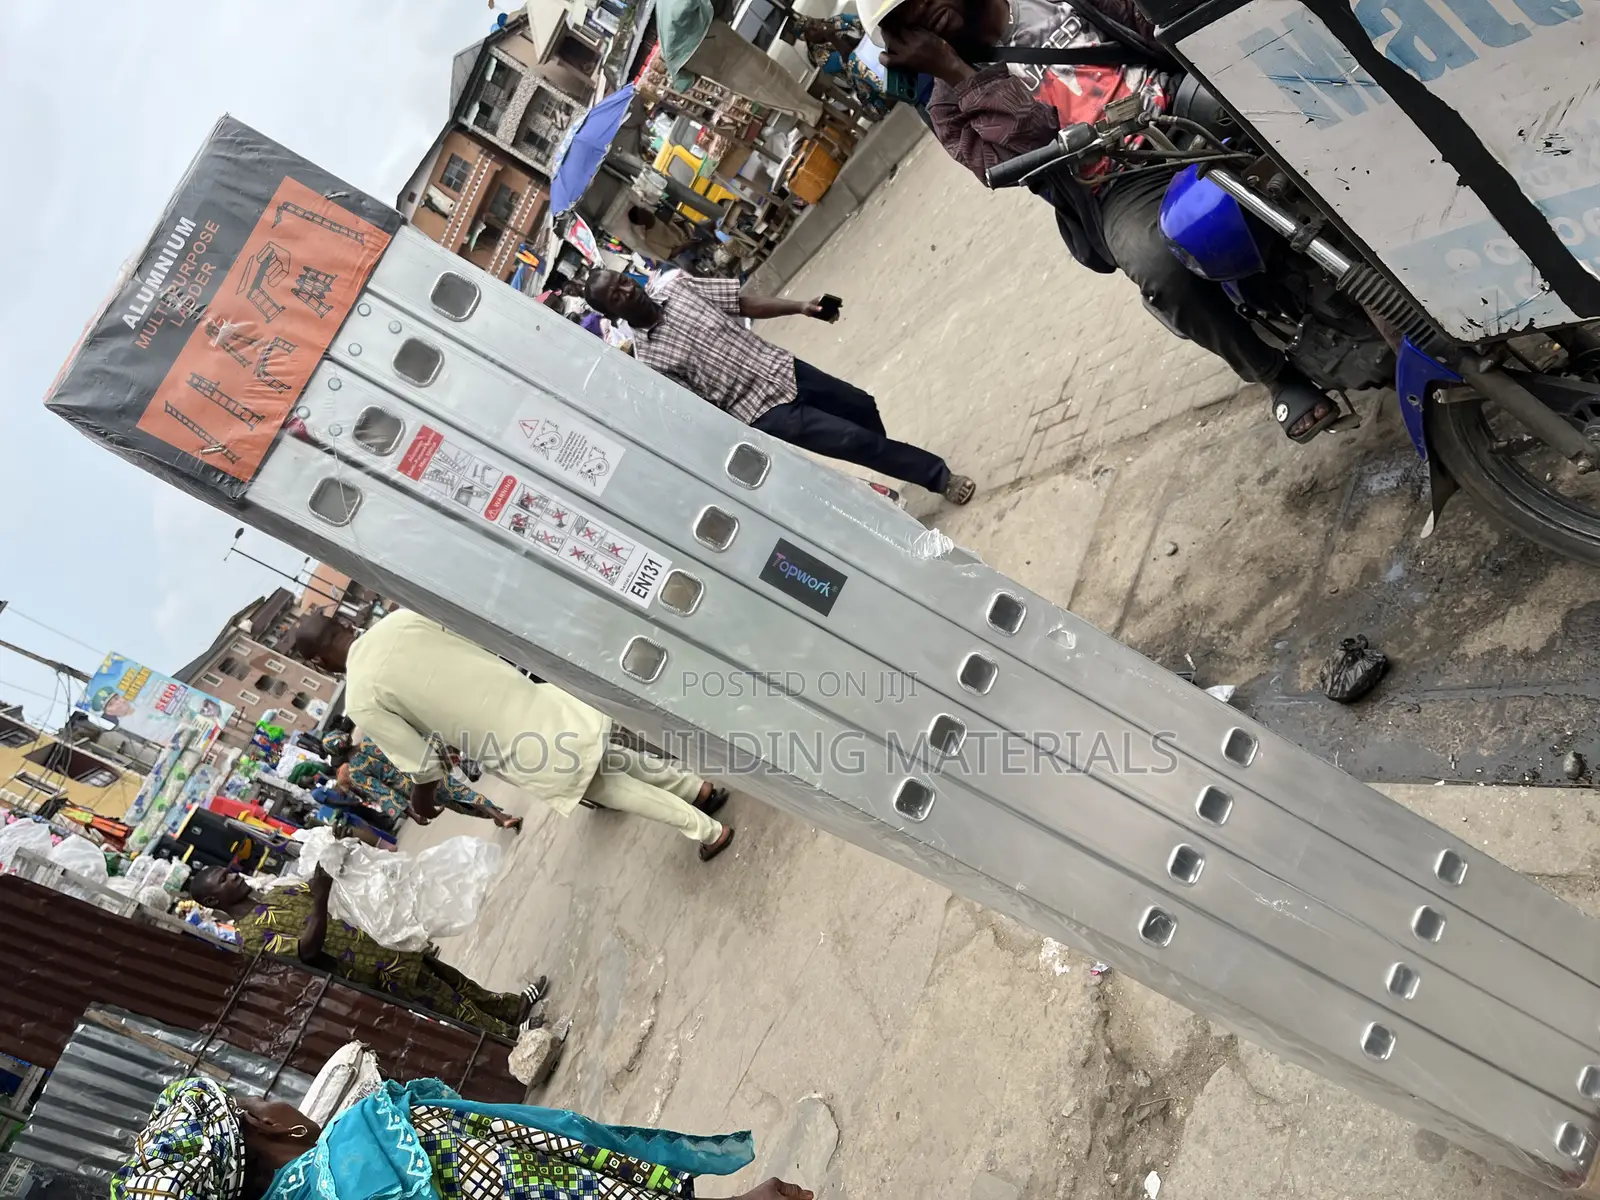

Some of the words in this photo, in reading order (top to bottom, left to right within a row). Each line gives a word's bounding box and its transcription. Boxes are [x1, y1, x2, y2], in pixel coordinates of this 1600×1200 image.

[122, 216, 197, 331] ALUMNIUM
[169, 261, 217, 327] LADDER
[494, 478, 515, 508] WARNING
[630, 558, 663, 600] EN131
